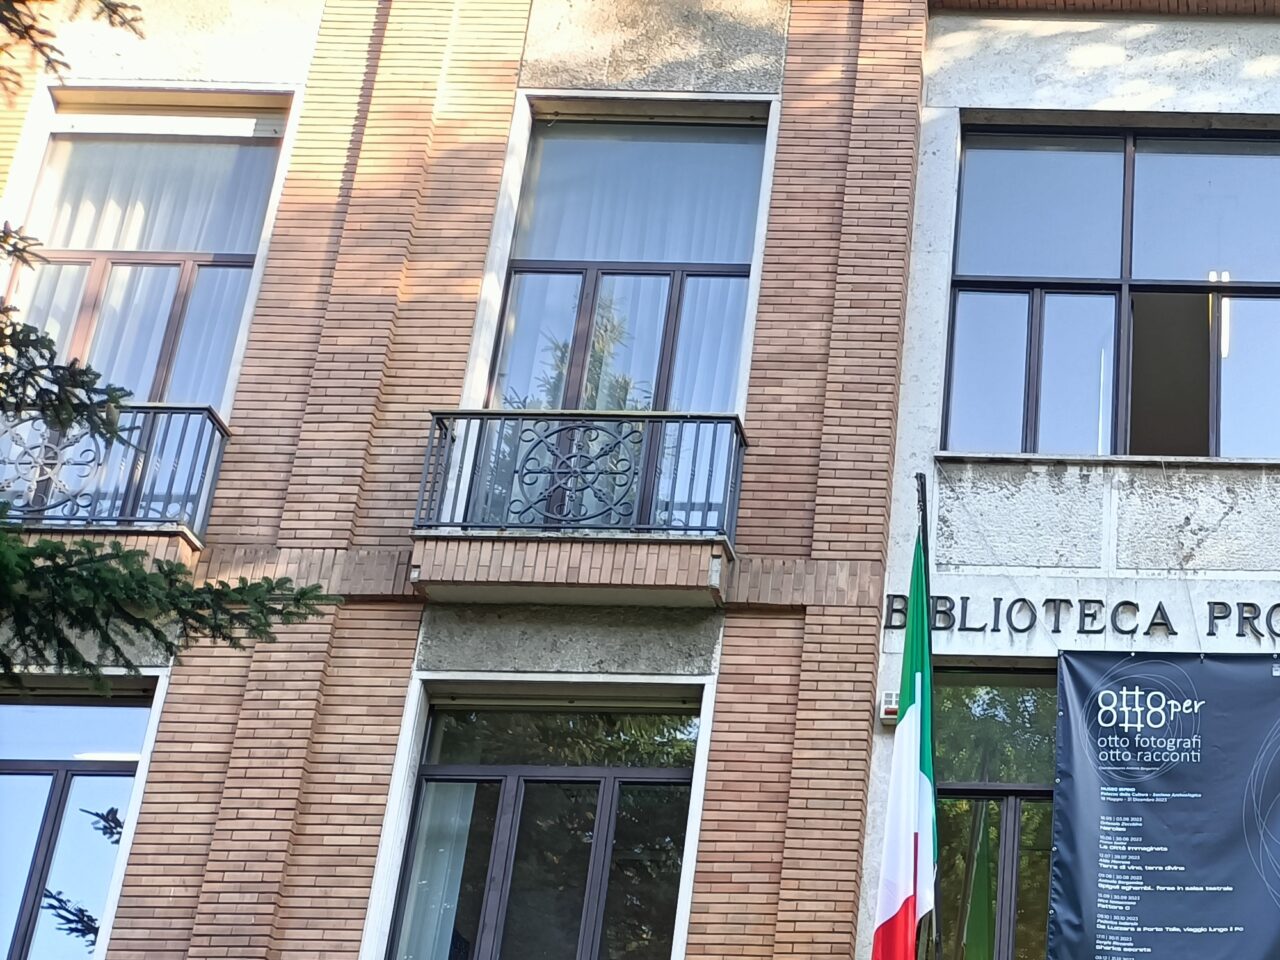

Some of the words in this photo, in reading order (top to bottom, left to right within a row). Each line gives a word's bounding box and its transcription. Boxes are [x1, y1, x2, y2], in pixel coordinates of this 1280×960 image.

[884, 594, 1178, 636] BBLIOTECA
[1167, 699, 1205, 720] per
[1097, 735, 1130, 748] otto
[1135, 734, 1201, 751] fotografi
[1099, 749, 1131, 762] otto
[1137, 749, 1201, 762] racconti
